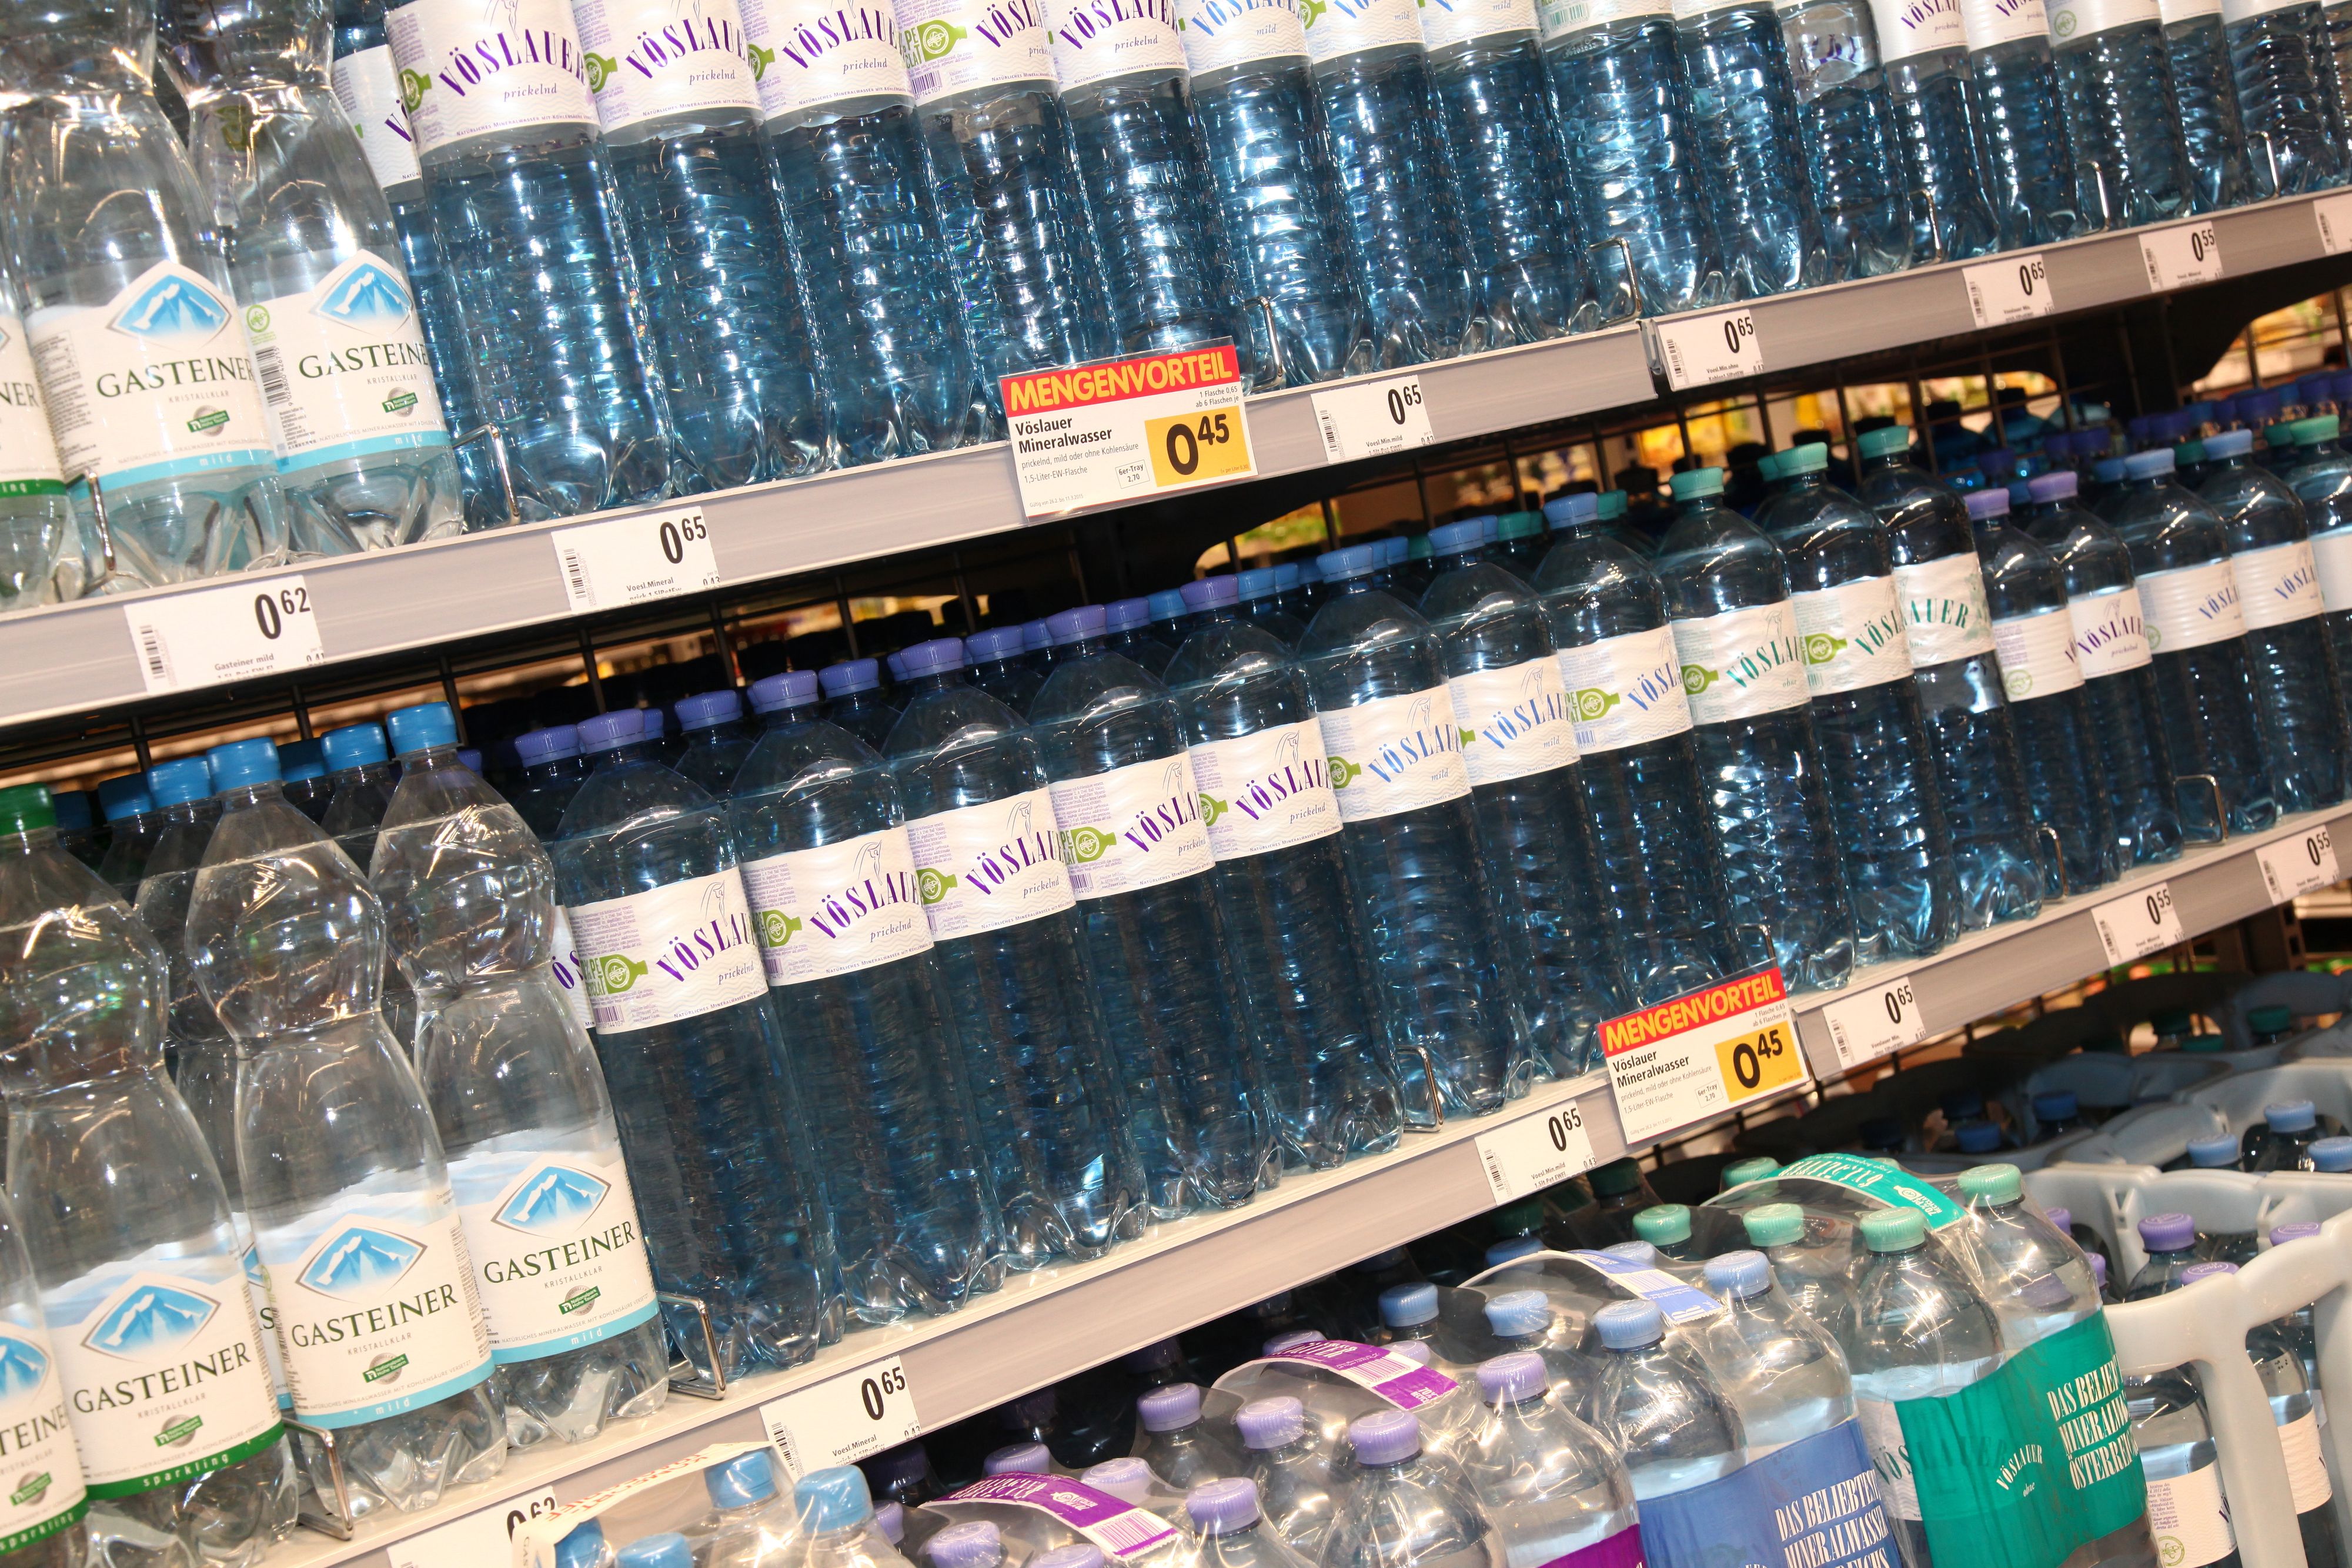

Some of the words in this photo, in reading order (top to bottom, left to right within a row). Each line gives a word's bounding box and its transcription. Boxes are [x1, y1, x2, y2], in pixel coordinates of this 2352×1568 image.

[1394, 11, 1410, 21] mild
[1256, 24, 1277, 36] mild
[1114, 35, 1158, 51] prickelnd
[438, 27, 586, 98] VÖSLAUER
[843, 58, 888, 75] prickelnd
[689, 68, 736, 84] prickelnd
[503, 83, 557, 102] prickelnd
[299, 342, 429, 378] GASTEINE
[96, 357, 256, 398] GASTEINER
[1010, 351, 1232, 411] MENGENVORTEIL
[169, 390, 229, 403] KRISTALLKLAR
[1204, 387, 1225, 398] Flasche
[1226, 386, 1238, 394] 0,65
[1210, 396, 1232, 406] Flaschen
[1234, 394, 1239, 403] je
[1015, 416, 1073, 436] Vöslauer
[1018, 427, 1112, 453] Mineralwasser
[200, 454, 233, 466] mild
[1021, 456, 1053, 471] prickelnd,
[1054, 453, 1067, 464] mild
[1069, 450, 1083, 461] oder
[1085, 447, 1100, 458] ohne
[1102, 442, 1139, 455] Kohlensäure
[1024, 464, 1088, 484] 1,5-Liter-EW-Flasche
[1118, 463, 1144, 476] 6er-Tray
[1128, 473, 1140, 483] 2,70
[214, 657, 254, 671] Gasteiner
[256, 653, 275, 663] mild
[1543, 736, 1561, 748] mild
[1431, 768, 1448, 781] mild
[1289, 802, 1325, 824] prickelnd
[1023, 876, 1059, 898] prickelnd
[870, 918, 911, 942] prickelnd
[718, 961, 754, 985] prickelnd
[1605, 974, 1780, 1052] MENGENVORTEIL
[1758, 1007, 1775, 1017] Flasche
[1775, 1003, 1786, 1012] 0,65
[1763, 1014, 1781, 1025] Flaschen
[1782, 1011, 1787, 1020] je
[1612, 1050, 1657, 1073] Vöslauer
[1616, 1055, 1690, 1088] Mineralwasser
[1621, 1087, 1645, 1102] prickelnd,
[1646, 1084, 1657, 1094] mild
[1658, 1081, 1669, 1090] oder
[1669, 1077, 1682, 1086] ohne
[1682, 1065, 1712, 1081] Kohlensäure
[1697, 1084, 1718, 1097] 6er-Tray
[1623, 1091, 1673, 1114] 1,5-Liter-EW-Flasche
[1705, 1092, 1715, 1102] 2,70
[484, 1221, 635, 1283] GASTEINER
[544, 1266, 603, 1289] KRISTALLKLAR
[292, 1284, 457, 1348] GASTEINER
[502, 1332, 537, 1343] NATÜRLICHES
[538, 1319, 586, 1337] MINERALWASSER
[587, 1315, 597, 1323] MIT
[599, 1301, 633, 1319] KOHLENSÄURE
[348, 1332, 412, 1355] KRISTALLKLAR
[571, 1328, 602, 1345] mild
[74, 1342, 252, 1414] GASTEINER
[138, 1392, 206, 1419] KRISTALLKLAR
[376, 1398, 410, 1415] mild
[2046, 1384, 2076, 1422] DAS
[143, 1453, 230, 1487] sparkling
[1996, 1444, 2043, 1491] VÖSLAUER
[2023, 1481, 2036, 1497] ohne
[1775, 1500, 1804, 1542] DAS
